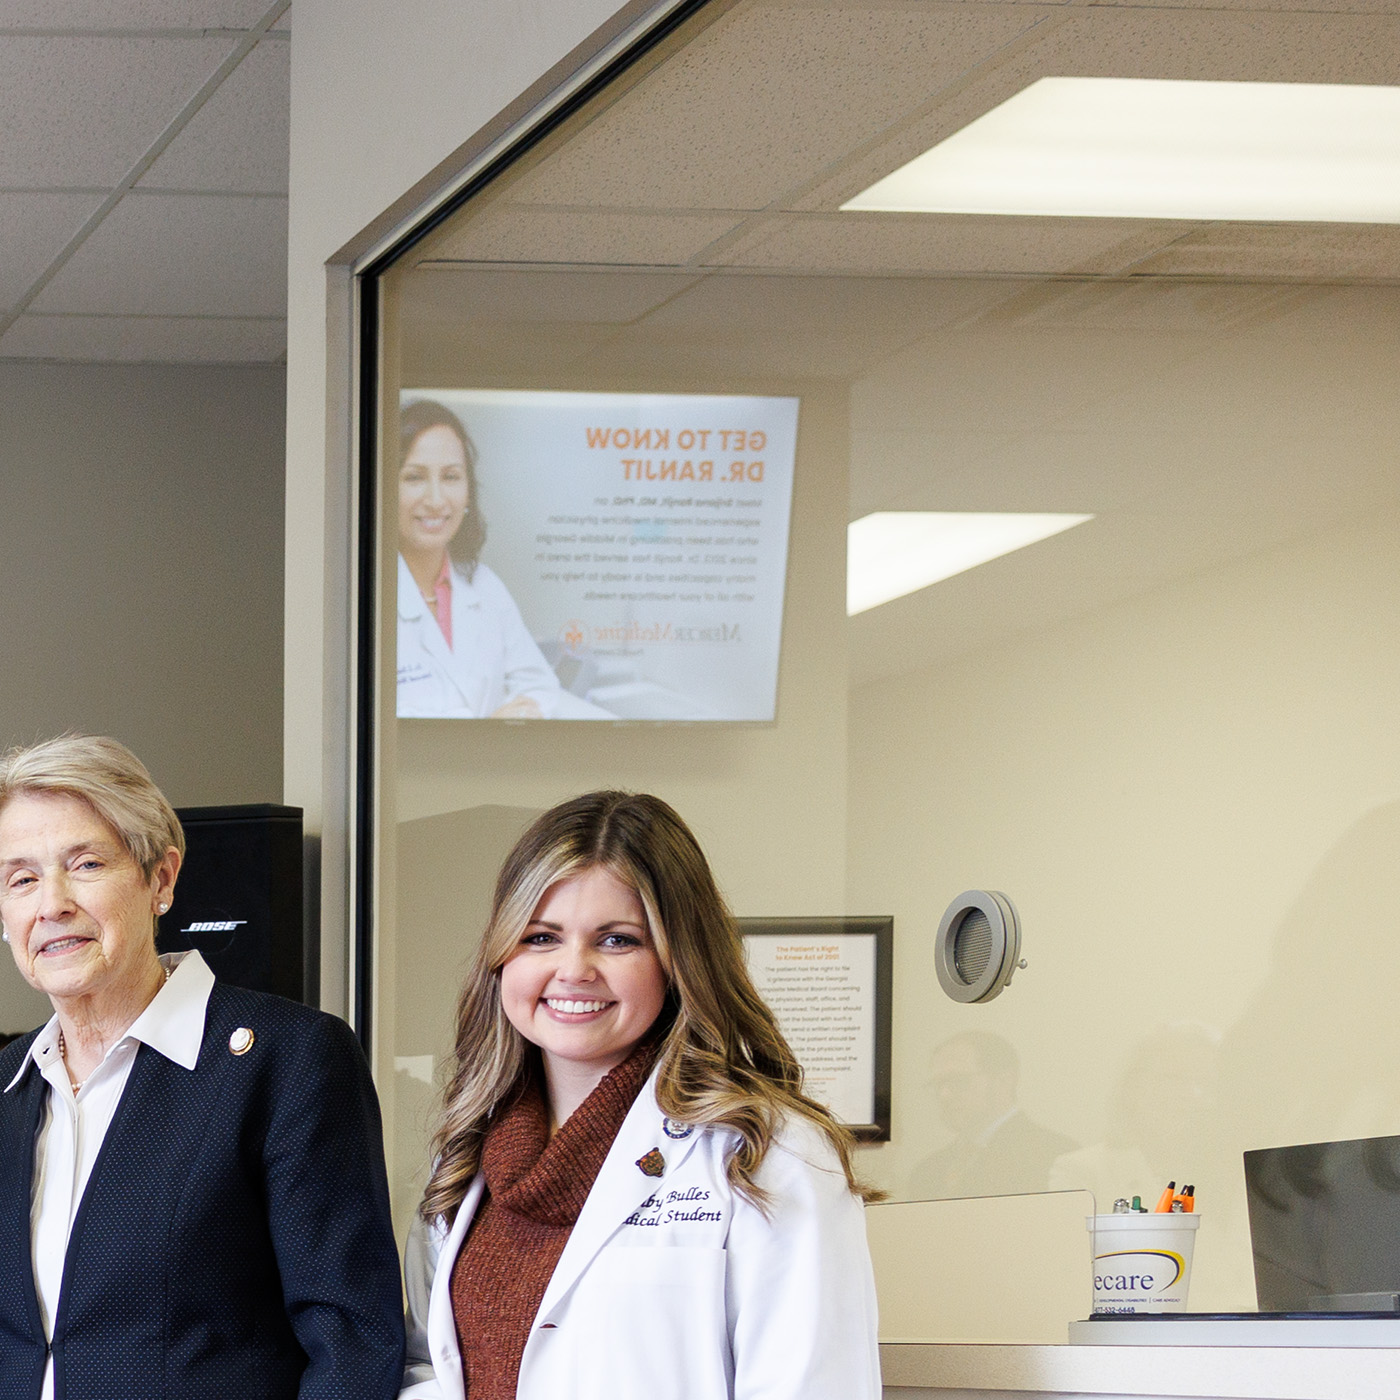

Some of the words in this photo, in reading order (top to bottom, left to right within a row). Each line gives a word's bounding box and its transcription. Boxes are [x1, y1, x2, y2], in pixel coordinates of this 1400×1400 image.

[183, 921, 244, 932] BOSE
[666, 1186, 711, 1204] Bulles
[623, 1212, 662, 1226] dical
[664, 1207, 722, 1224] Student
